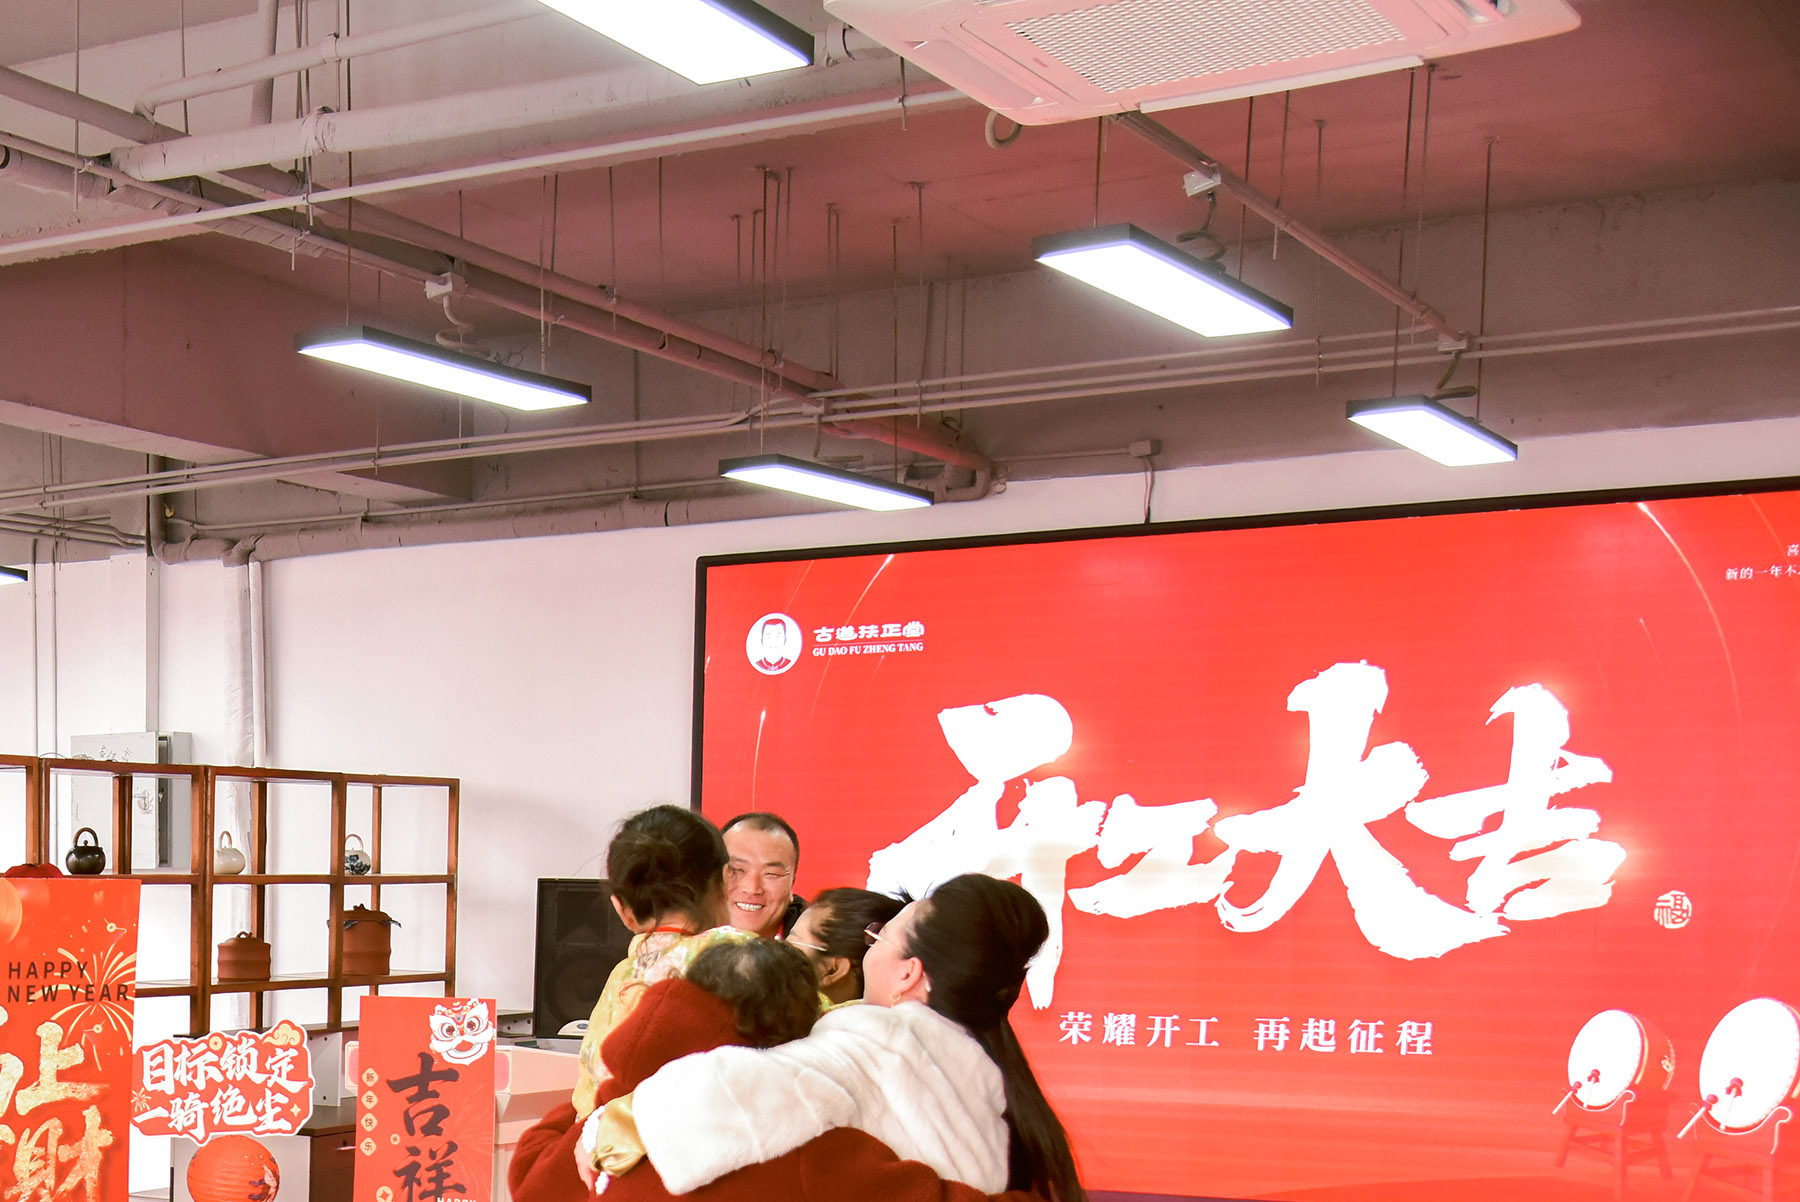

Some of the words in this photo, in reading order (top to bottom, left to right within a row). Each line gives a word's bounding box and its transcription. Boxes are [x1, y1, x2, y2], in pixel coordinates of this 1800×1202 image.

[1726, 565, 1800, 580] 新的一年不
[813, 621, 925, 643] 古道扶正堂
[812, 647, 826, 656] GU
[828, 645, 847, 656] DAO
[850, 645, 861, 655] FU
[863, 643, 896, 654] ZHENG
[897, 642, 924, 652] TANG
[869, 659, 1627, 1009] 开工大吉
[8, 961, 88, 979] HAPPY
[7, 984, 61, 1002] NEW
[70, 984, 129, 1002] YEAR
[1059, 1012, 1219, 1047] 荣耀开工
[1253, 1017, 1433, 1055] 再起征程
[142, 1036, 308, 1095] 目标锁定
[133, 1084, 292, 1142] 一骑绝尘
[364, 1073, 375, 1151] 新年快乐
